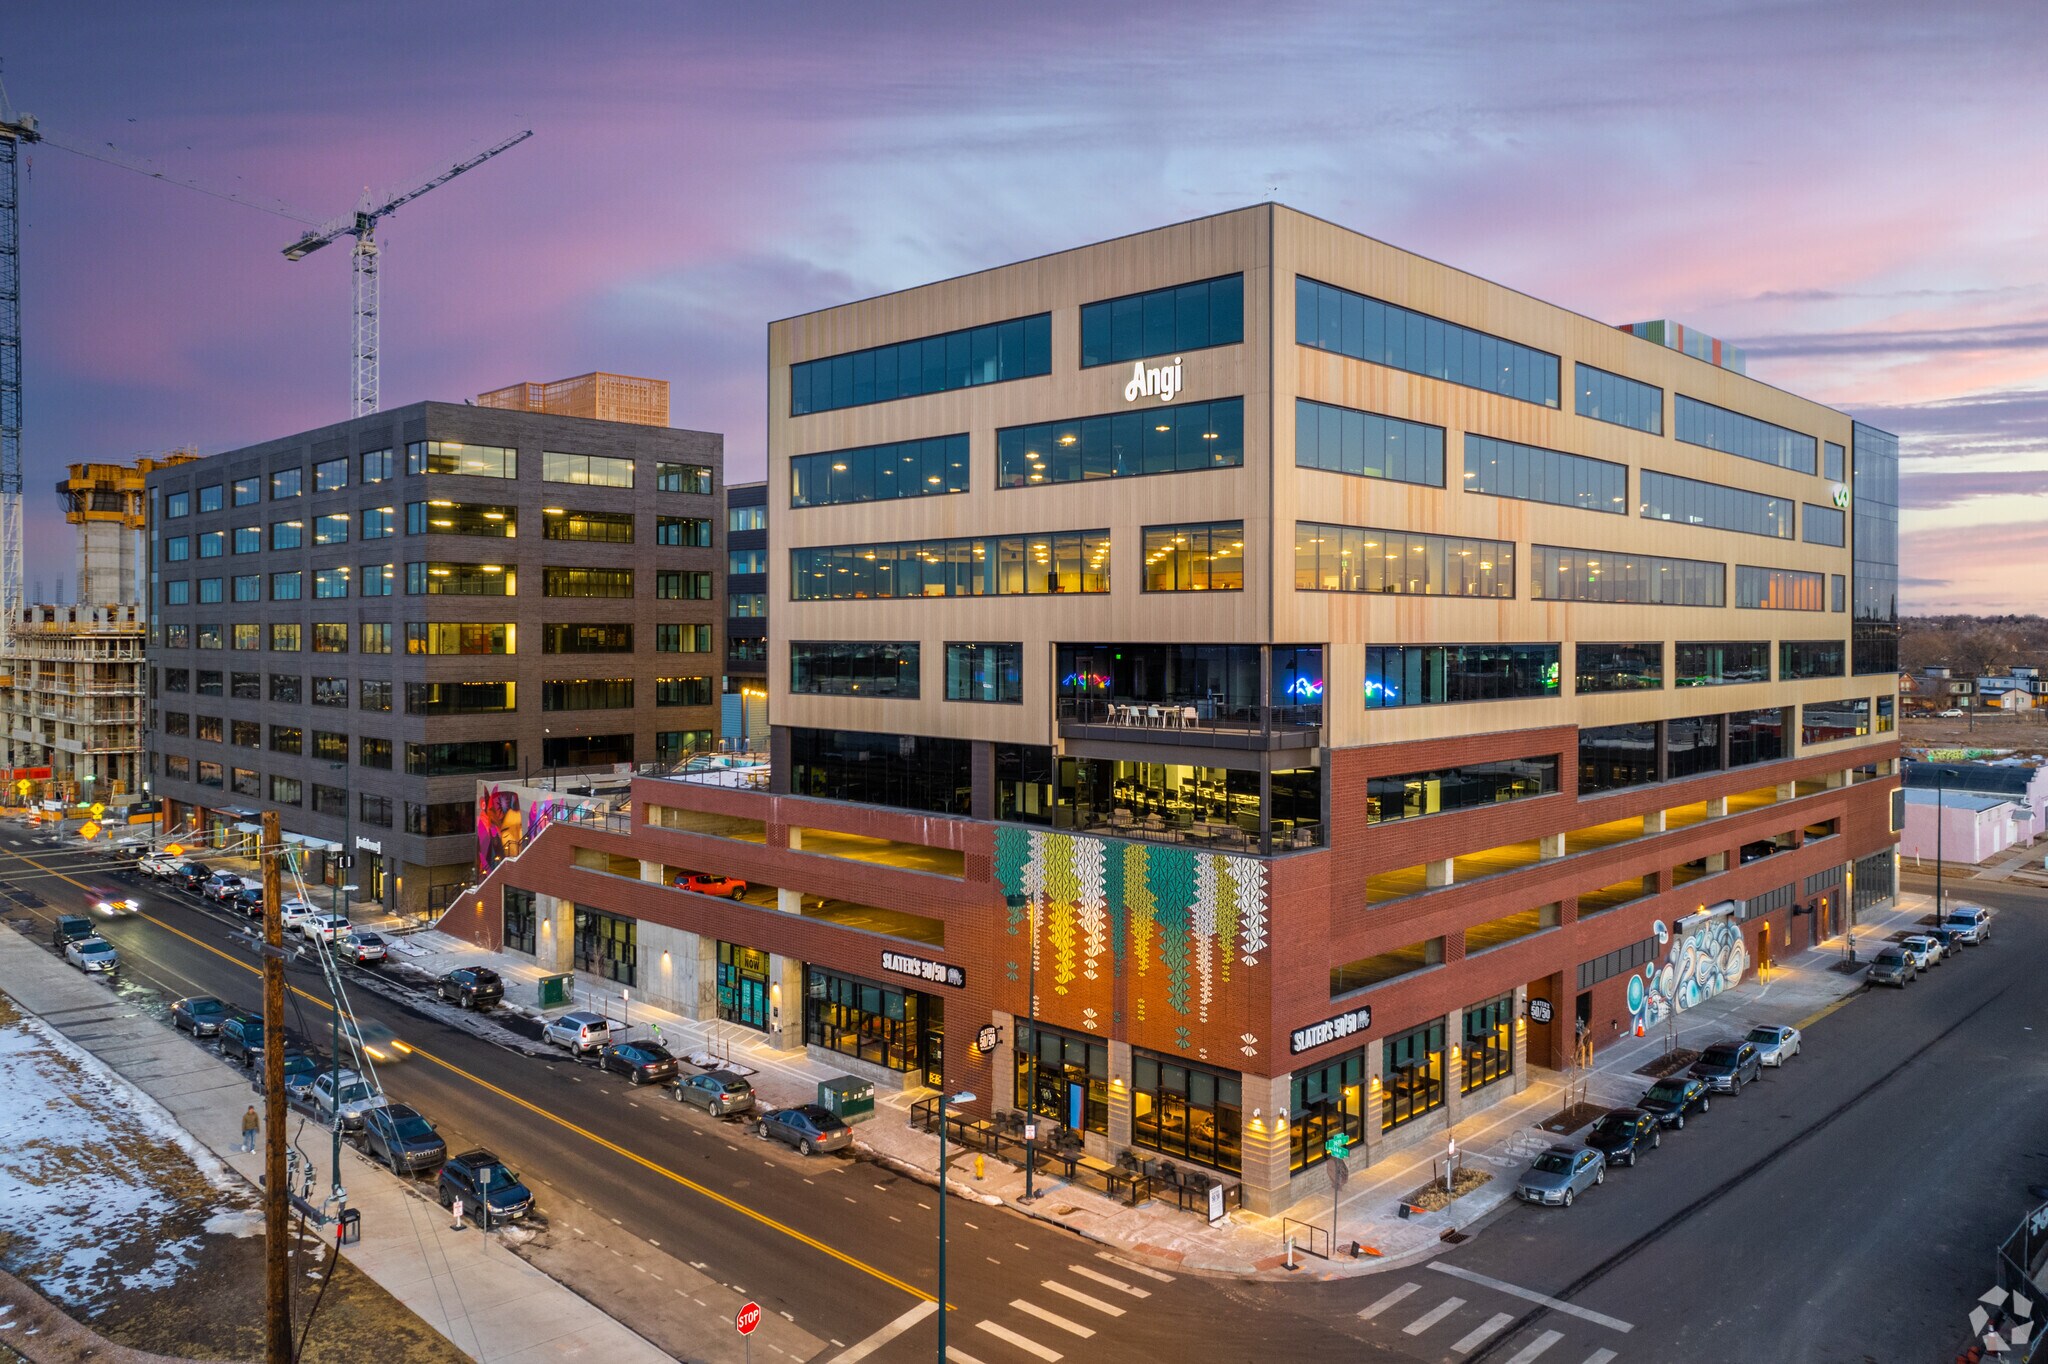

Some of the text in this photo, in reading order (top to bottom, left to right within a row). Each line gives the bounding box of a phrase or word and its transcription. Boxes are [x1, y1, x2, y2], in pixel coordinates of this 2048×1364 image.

[1125, 356, 1182, 402] Angi
[744, 958, 760, 971] NOW
[882, 952, 947, 982] SLATER'S 50/50
[1530, 1005, 1551, 1020] 50/50
[979, 1033, 996, 1049] 50/50
[1294, 1013, 1357, 1052] SLATER'S 50/50
[738, 1309, 759, 1328] STOP
